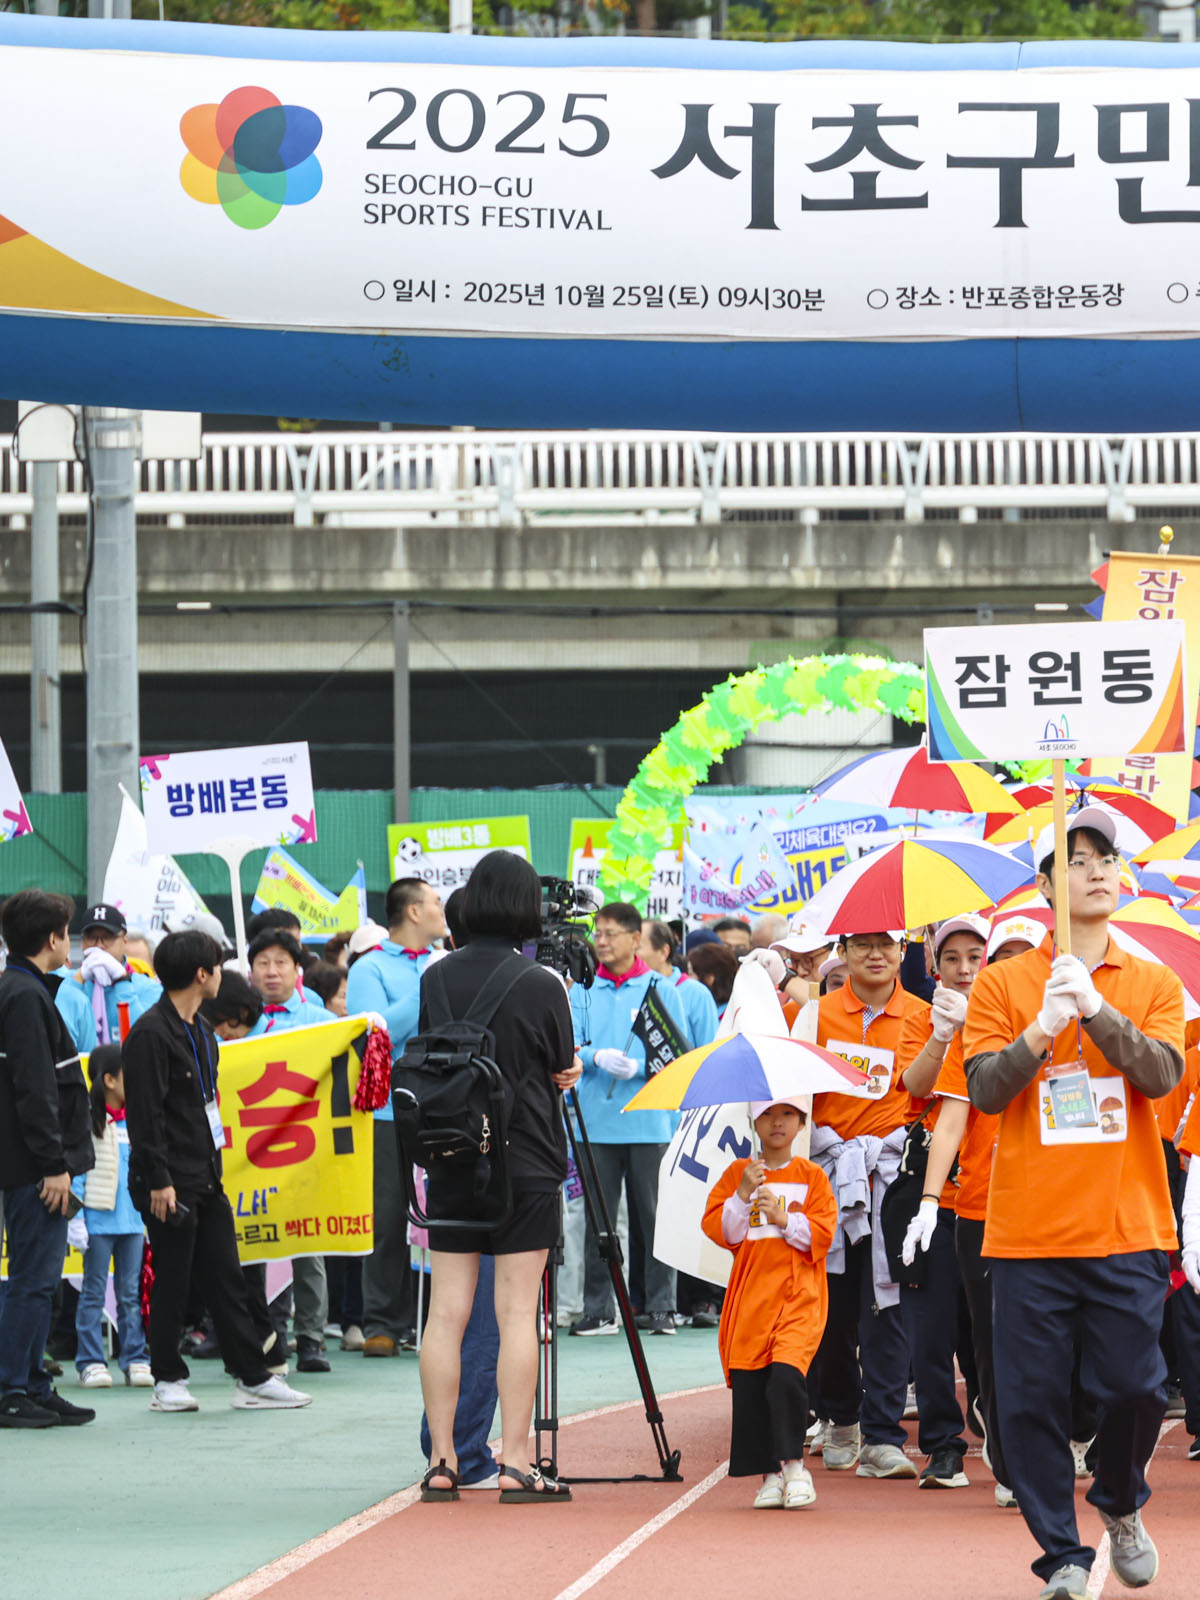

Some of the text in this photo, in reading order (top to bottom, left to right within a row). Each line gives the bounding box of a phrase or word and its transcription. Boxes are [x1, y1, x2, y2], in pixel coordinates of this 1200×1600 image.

[366, 87, 610, 157] 2025
[364, 173, 533, 199] SEOCHO-GU
[364, 204, 613, 232] SPORTS FESTIVAL
[463, 281, 545, 307] 2025년
[554, 284, 605, 309] 10월
[612, 284, 709, 310] 25일(토)
[718, 286, 825, 312] 09시30분
[961, 283, 1124, 309] 반포종합운동장
[955, 649, 1154, 709] 잠원동
[167, 774, 288, 817] 방배본동
[218, 1052, 354, 1168] 승!
